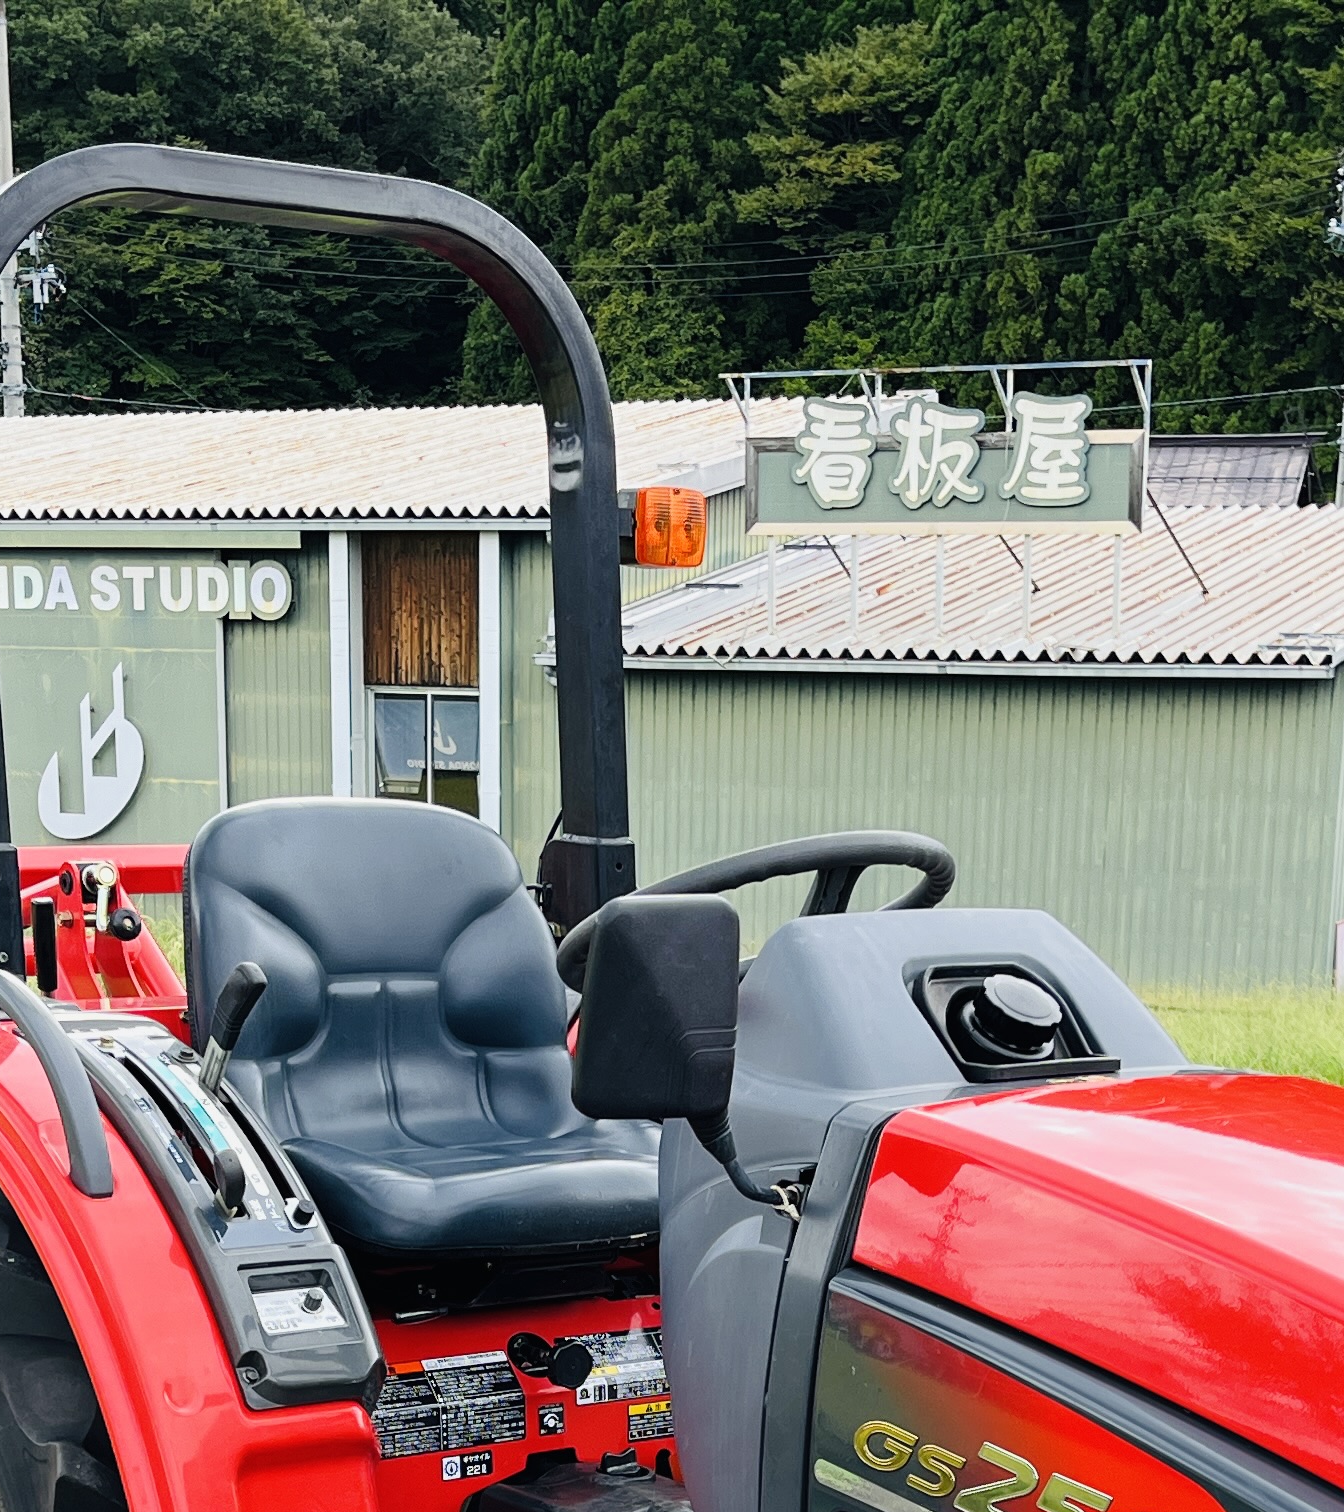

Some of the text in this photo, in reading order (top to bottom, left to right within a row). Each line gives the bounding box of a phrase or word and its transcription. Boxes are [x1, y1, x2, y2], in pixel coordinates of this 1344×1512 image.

[794, 395, 1089, 505] 看板屋
[90, 564, 288, 614] STUDIO
